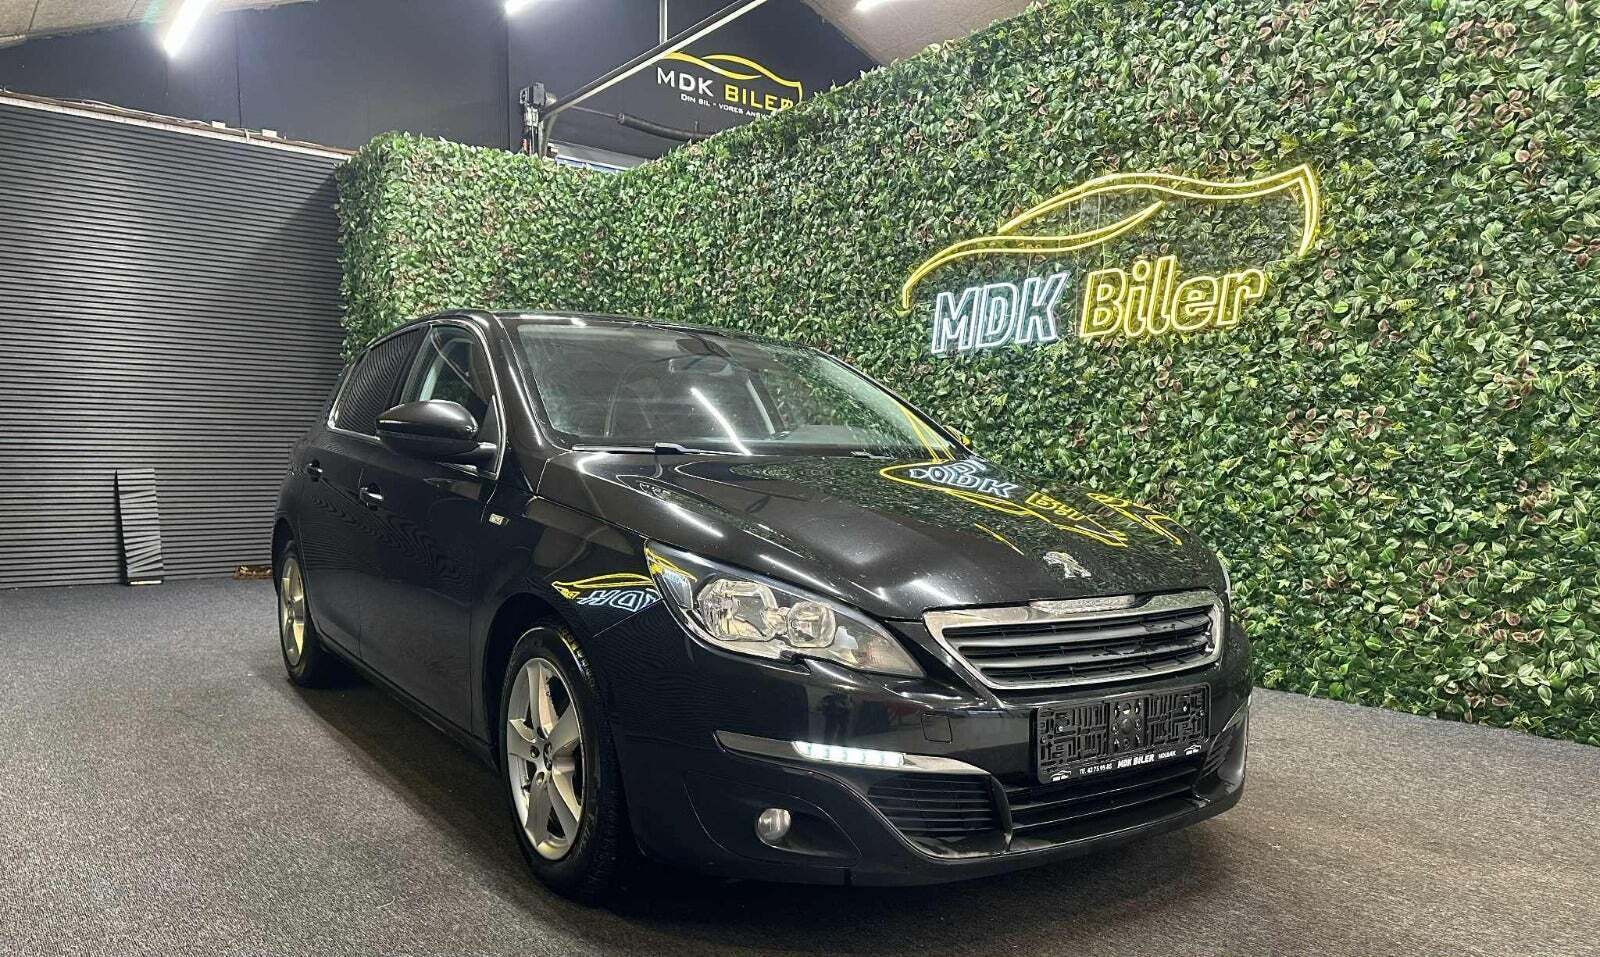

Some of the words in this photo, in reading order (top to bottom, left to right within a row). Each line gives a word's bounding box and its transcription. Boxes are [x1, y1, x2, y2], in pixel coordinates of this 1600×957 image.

[657, 67, 714, 97] MDK
[931, 271, 1070, 354] MDK
[1079, 254, 1269, 338] Biler
